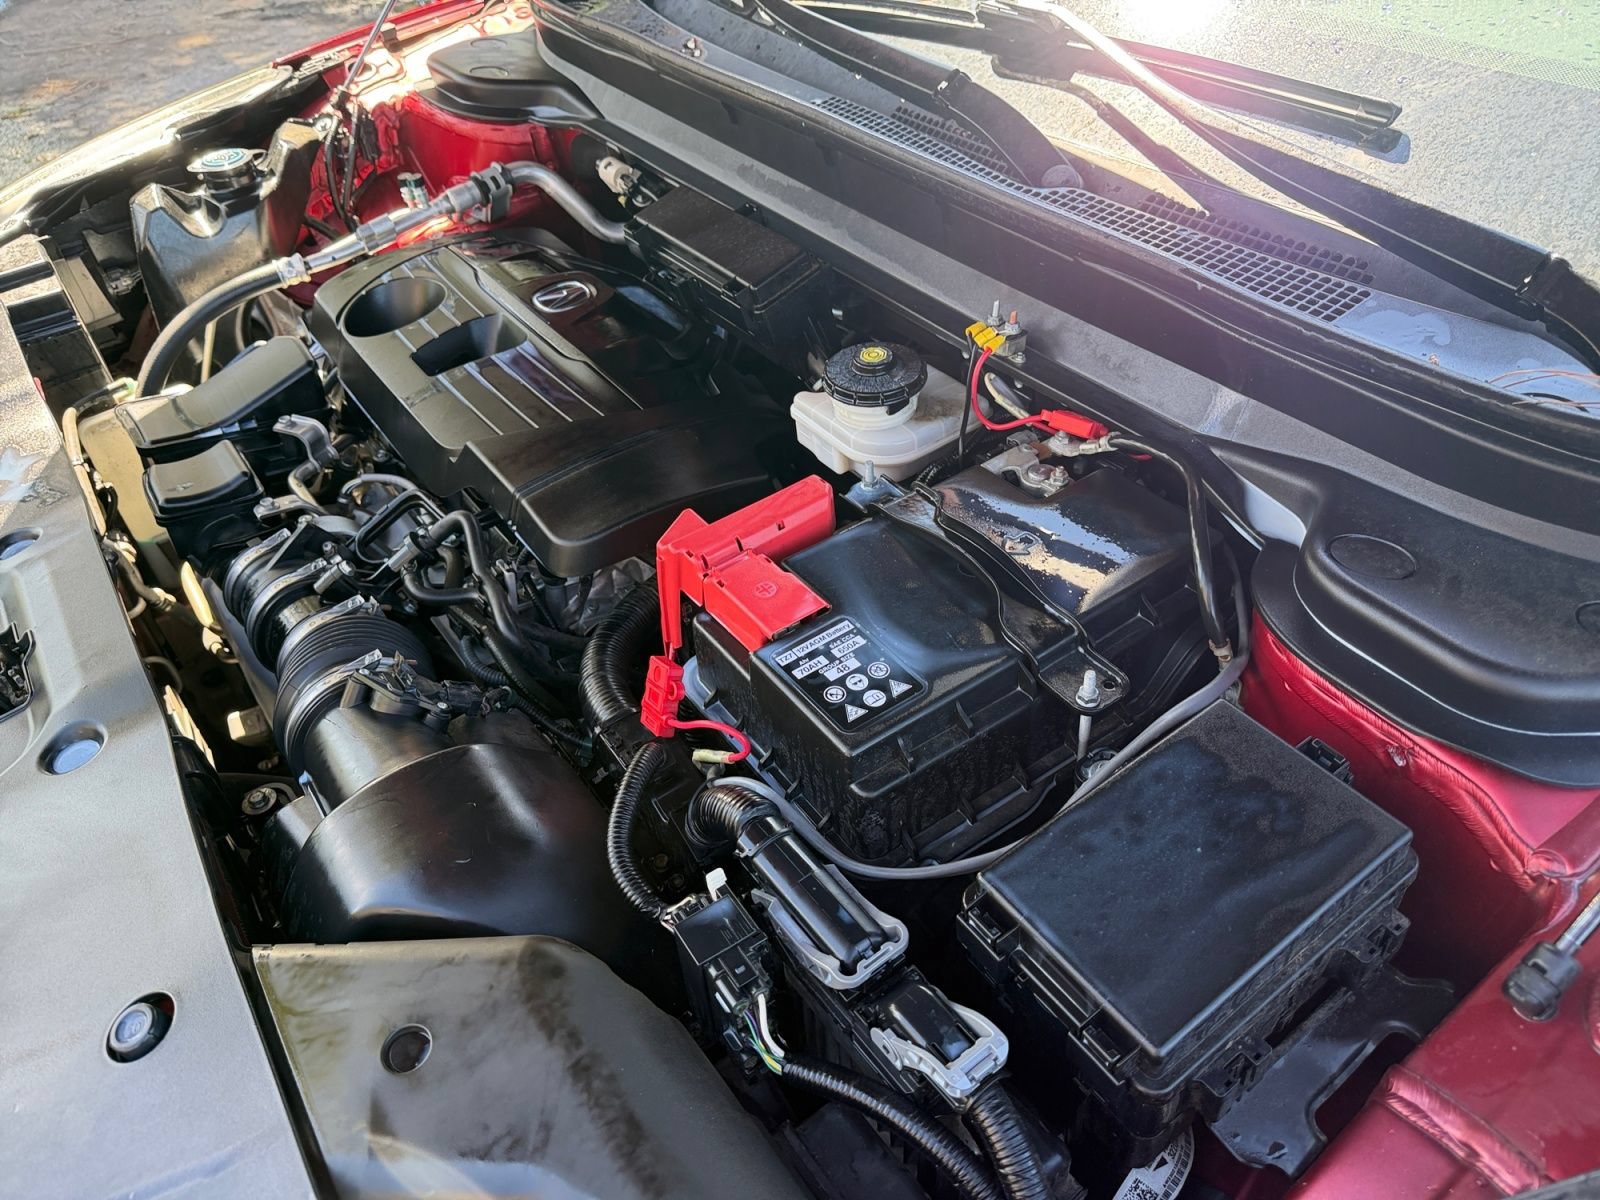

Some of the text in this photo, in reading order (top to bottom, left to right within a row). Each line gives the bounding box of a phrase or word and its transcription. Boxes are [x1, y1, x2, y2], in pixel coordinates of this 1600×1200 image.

[809, 634, 826, 647] AGM
[826, 623, 851, 638] Battery
[841, 633, 855, 642] CCA
[837, 640, 861, 654] 650A
[798, 660, 822, 676] 70AH
[818, 652, 856, 674] GROUP SIZE
[836, 663, 850, 674] 48
